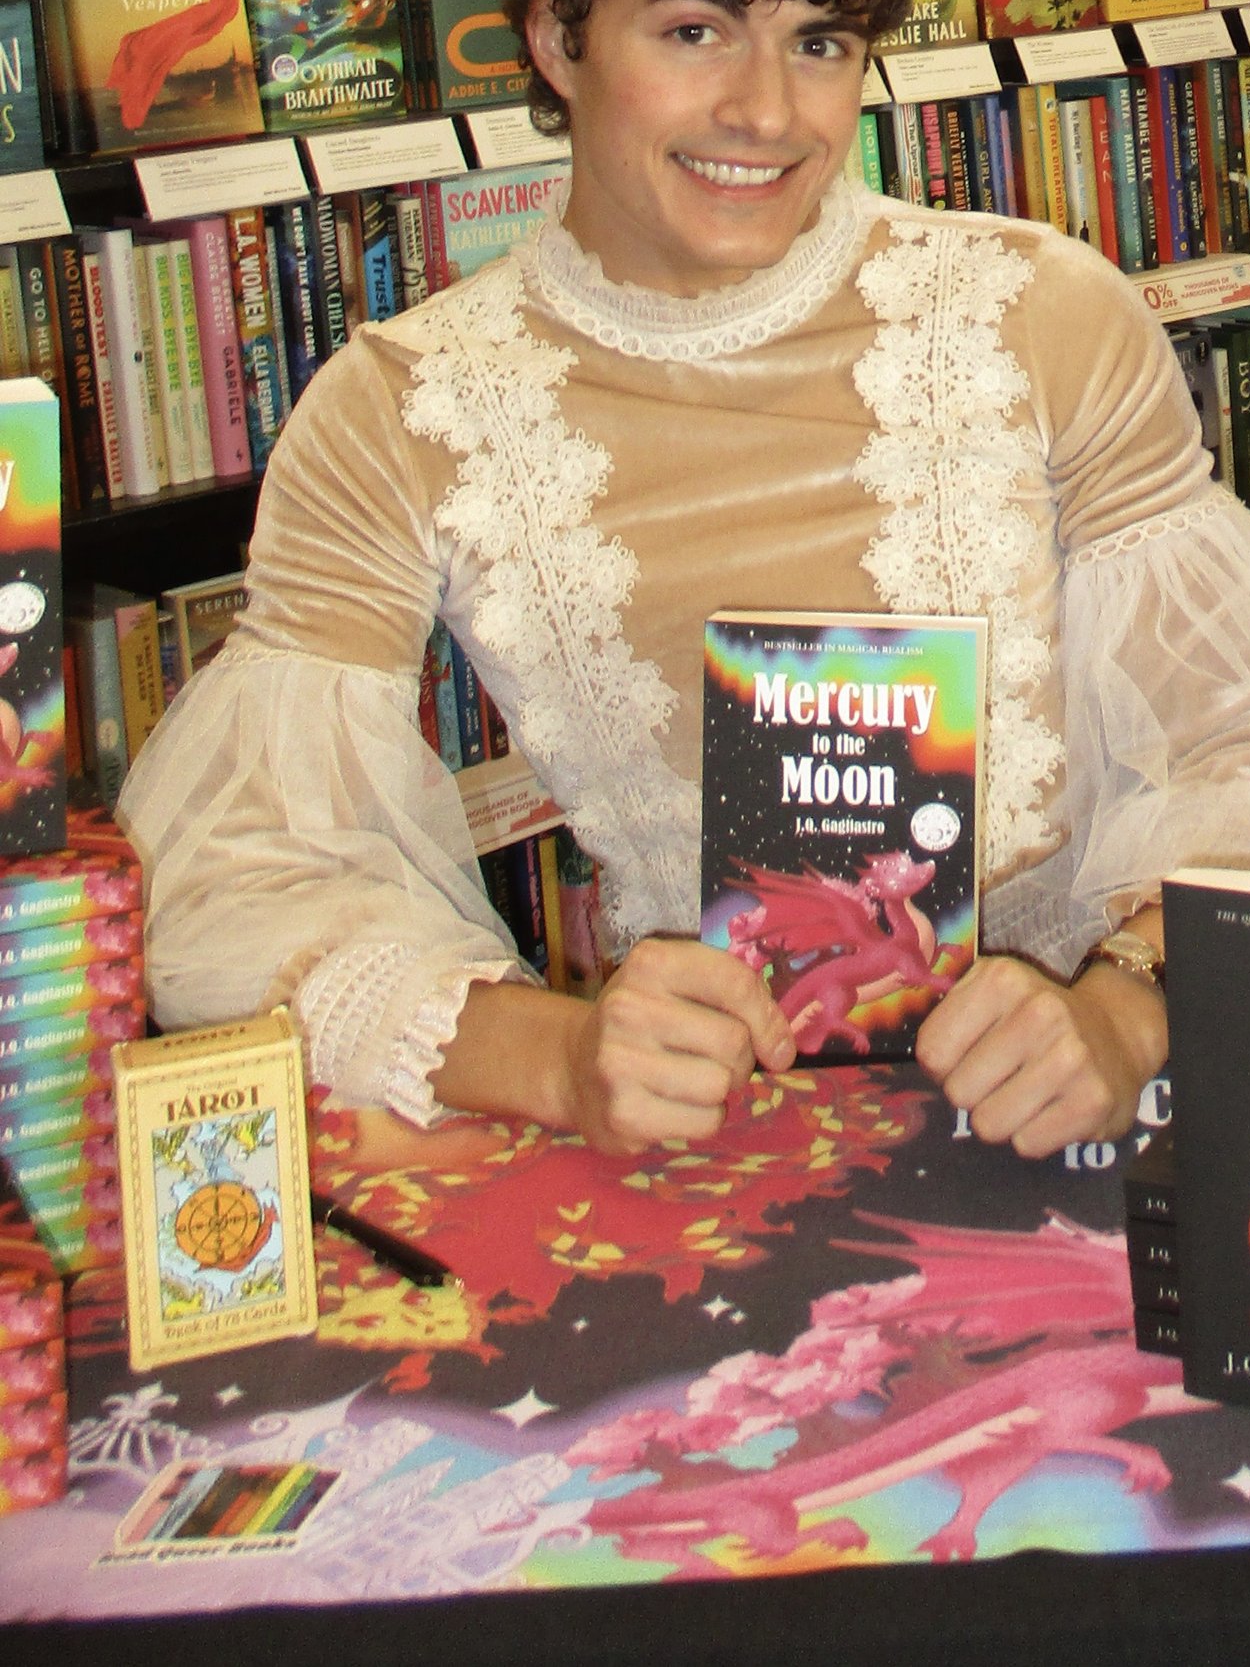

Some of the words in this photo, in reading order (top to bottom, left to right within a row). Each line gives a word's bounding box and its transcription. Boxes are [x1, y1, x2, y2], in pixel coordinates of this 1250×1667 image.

[301, 59, 377, 84] OYINKAN
[284, 78, 396, 110] BRAITHWAITE
[1184, 82, 1196, 123] GRAVE
[1136, 89, 1150, 144] STRANGE
[1141, 150, 1153, 181] FOLK
[1188, 128, 1198, 165] BIRDS
[62, 248, 85, 330] MOTHER
[241, 256, 267, 329] WOMEN
[73, 355, 94, 408] ROME
[222, 346, 242, 426] GABRIELE
[764, 640, 823, 651] BESTSELLER
[824, 643, 836, 652] IN
[838, 643, 881, 654] MAGICAL
[882, 645, 924, 655] REALISM
[753, 672, 938, 735] Mercury
[812, 732, 831, 755] to
[836, 733, 866, 755] the
[781, 755, 896, 807] Moon
[795, 817, 819, 835] J.Q.
[821, 817, 885, 836] Gagliastro
[1215, 909, 1239, 925] THE
[162, 1084, 264, 1122] TAROT
